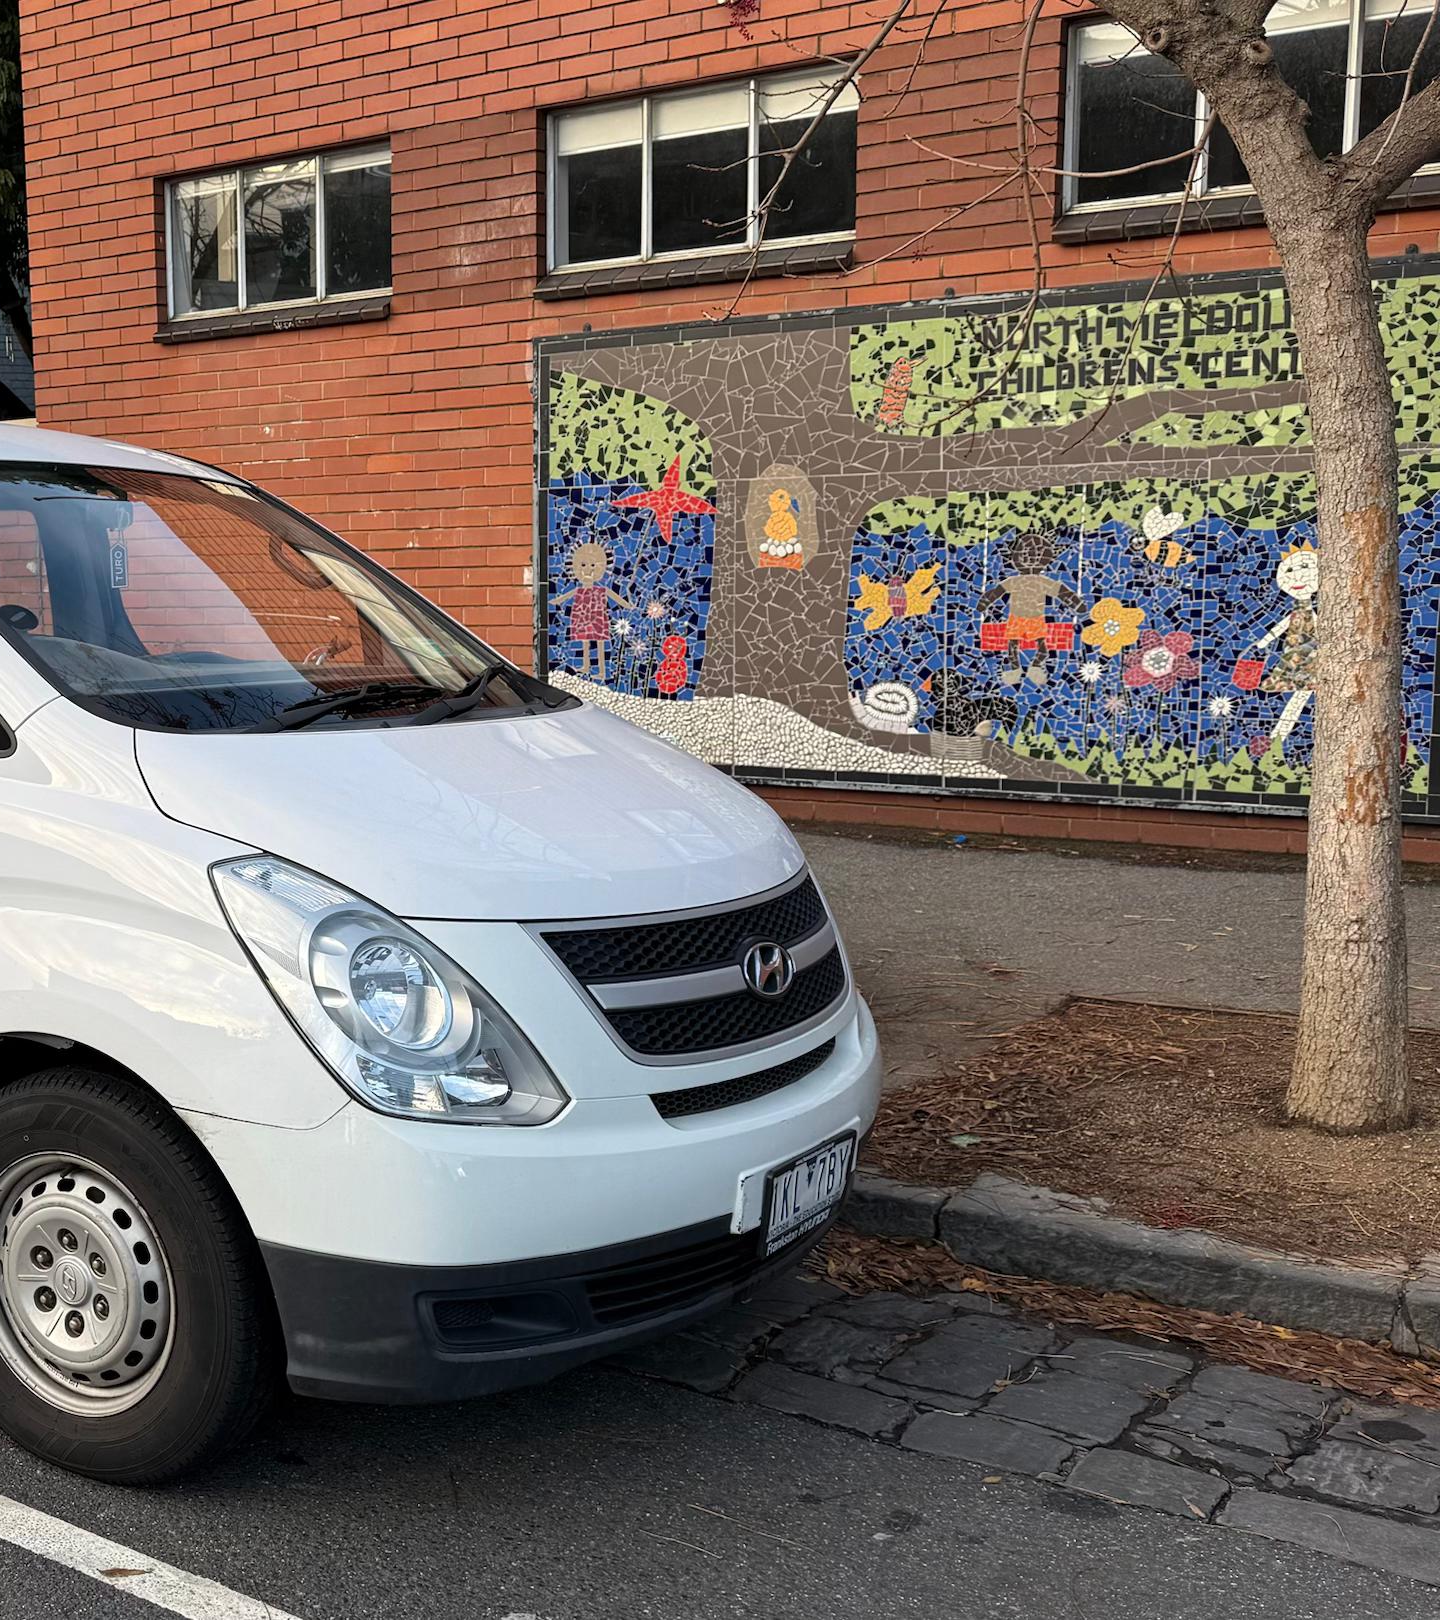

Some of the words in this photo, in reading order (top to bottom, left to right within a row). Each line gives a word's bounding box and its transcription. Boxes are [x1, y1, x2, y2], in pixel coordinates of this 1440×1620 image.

[982, 314, 1104, 350] NORTH
[1116, 300, 1291, 342] MELBOU
[977, 354, 1181, 396] CHILDRENS
[1200, 347, 1302, 379] CENT
[114, 550, 124, 582] TURO
[772, 1170, 800, 1226] 1KL
[817, 1144, 849, 1200] 7BY
[766, 1230, 799, 1256] Frankston
